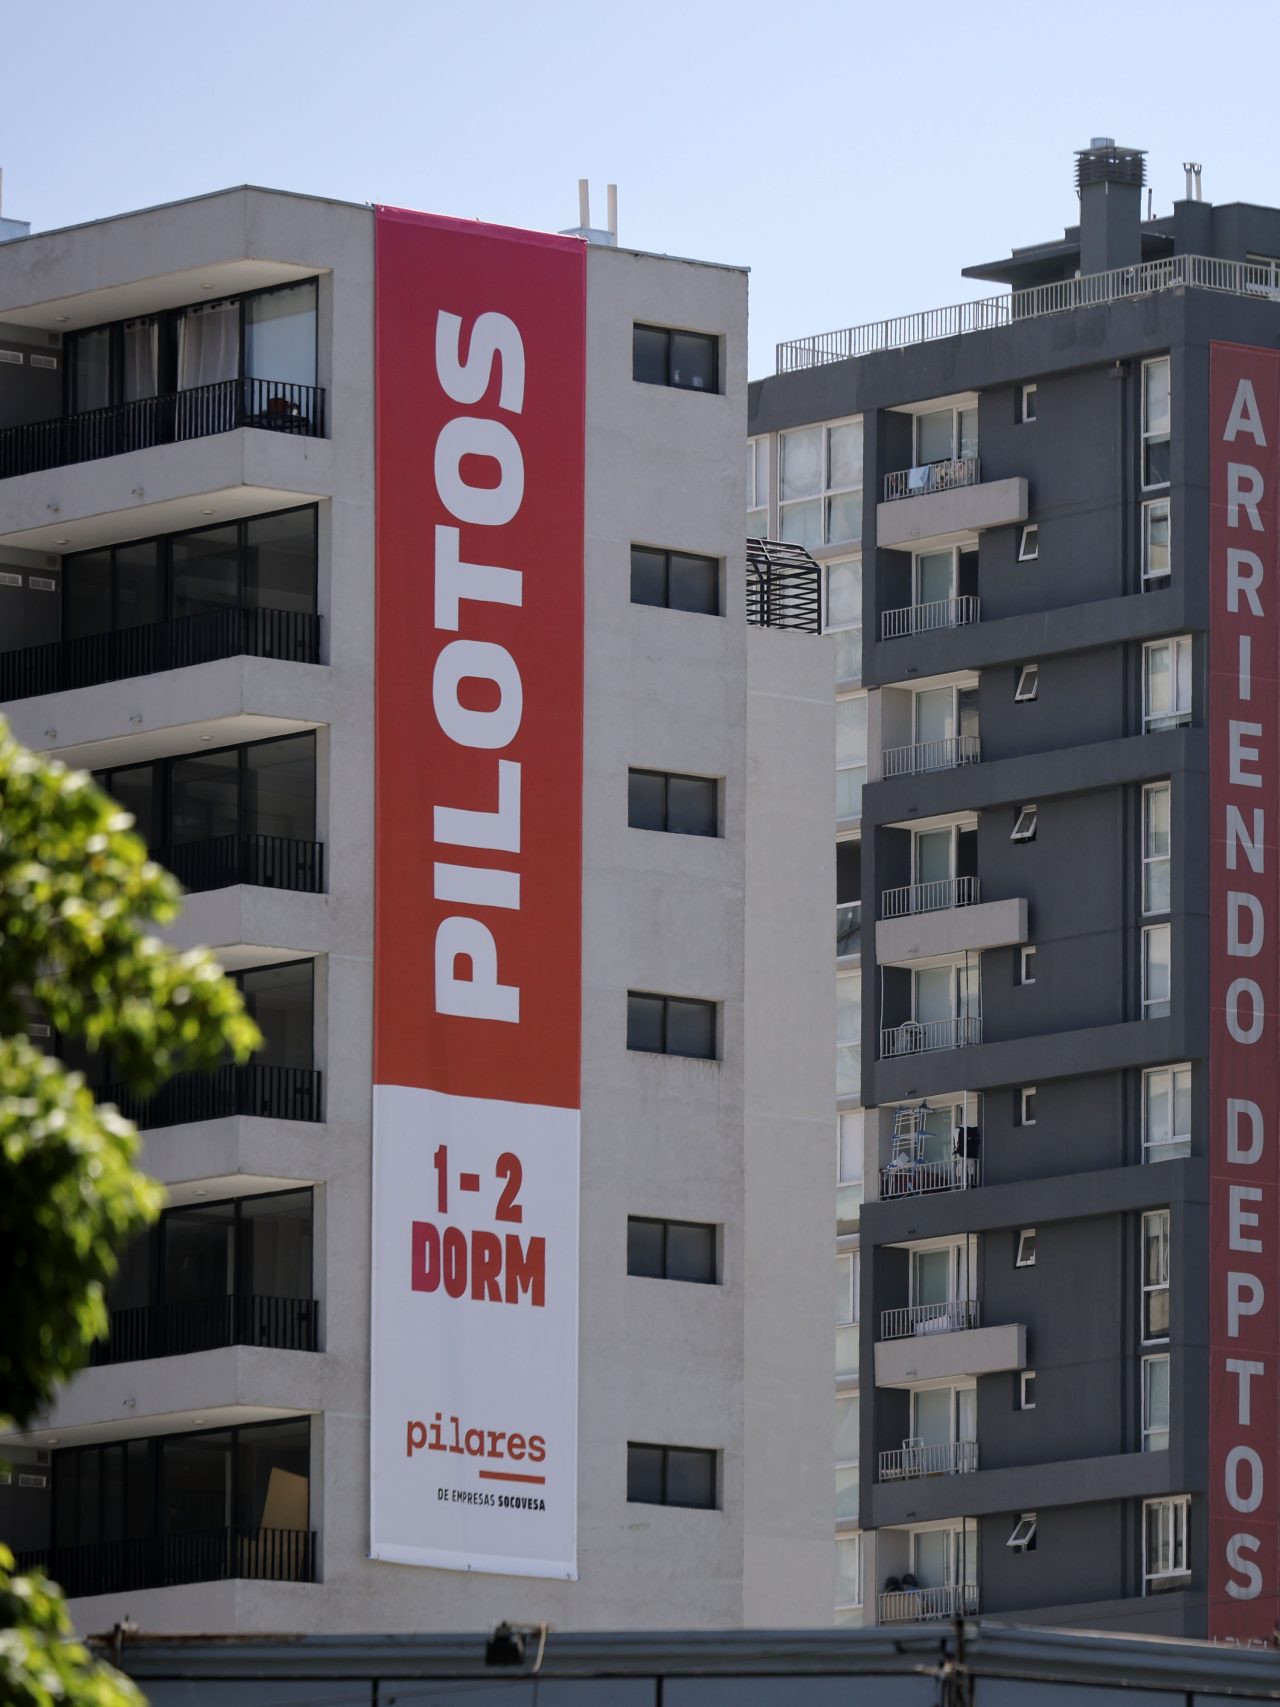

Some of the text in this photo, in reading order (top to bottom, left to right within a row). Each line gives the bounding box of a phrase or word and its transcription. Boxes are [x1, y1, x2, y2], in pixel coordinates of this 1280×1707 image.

[432, 310, 525, 1024] PILOTOS
[1222, 378, 1268, 1045] ARRIENDO
[412, 1221, 546, 1307] DORM
[1224, 1097, 1266, 1601] DEPTOS
[406, 1412, 546, 1462] pilares
[437, 1488, 546, 1512] DE EMPRESAS SOCOVESA
